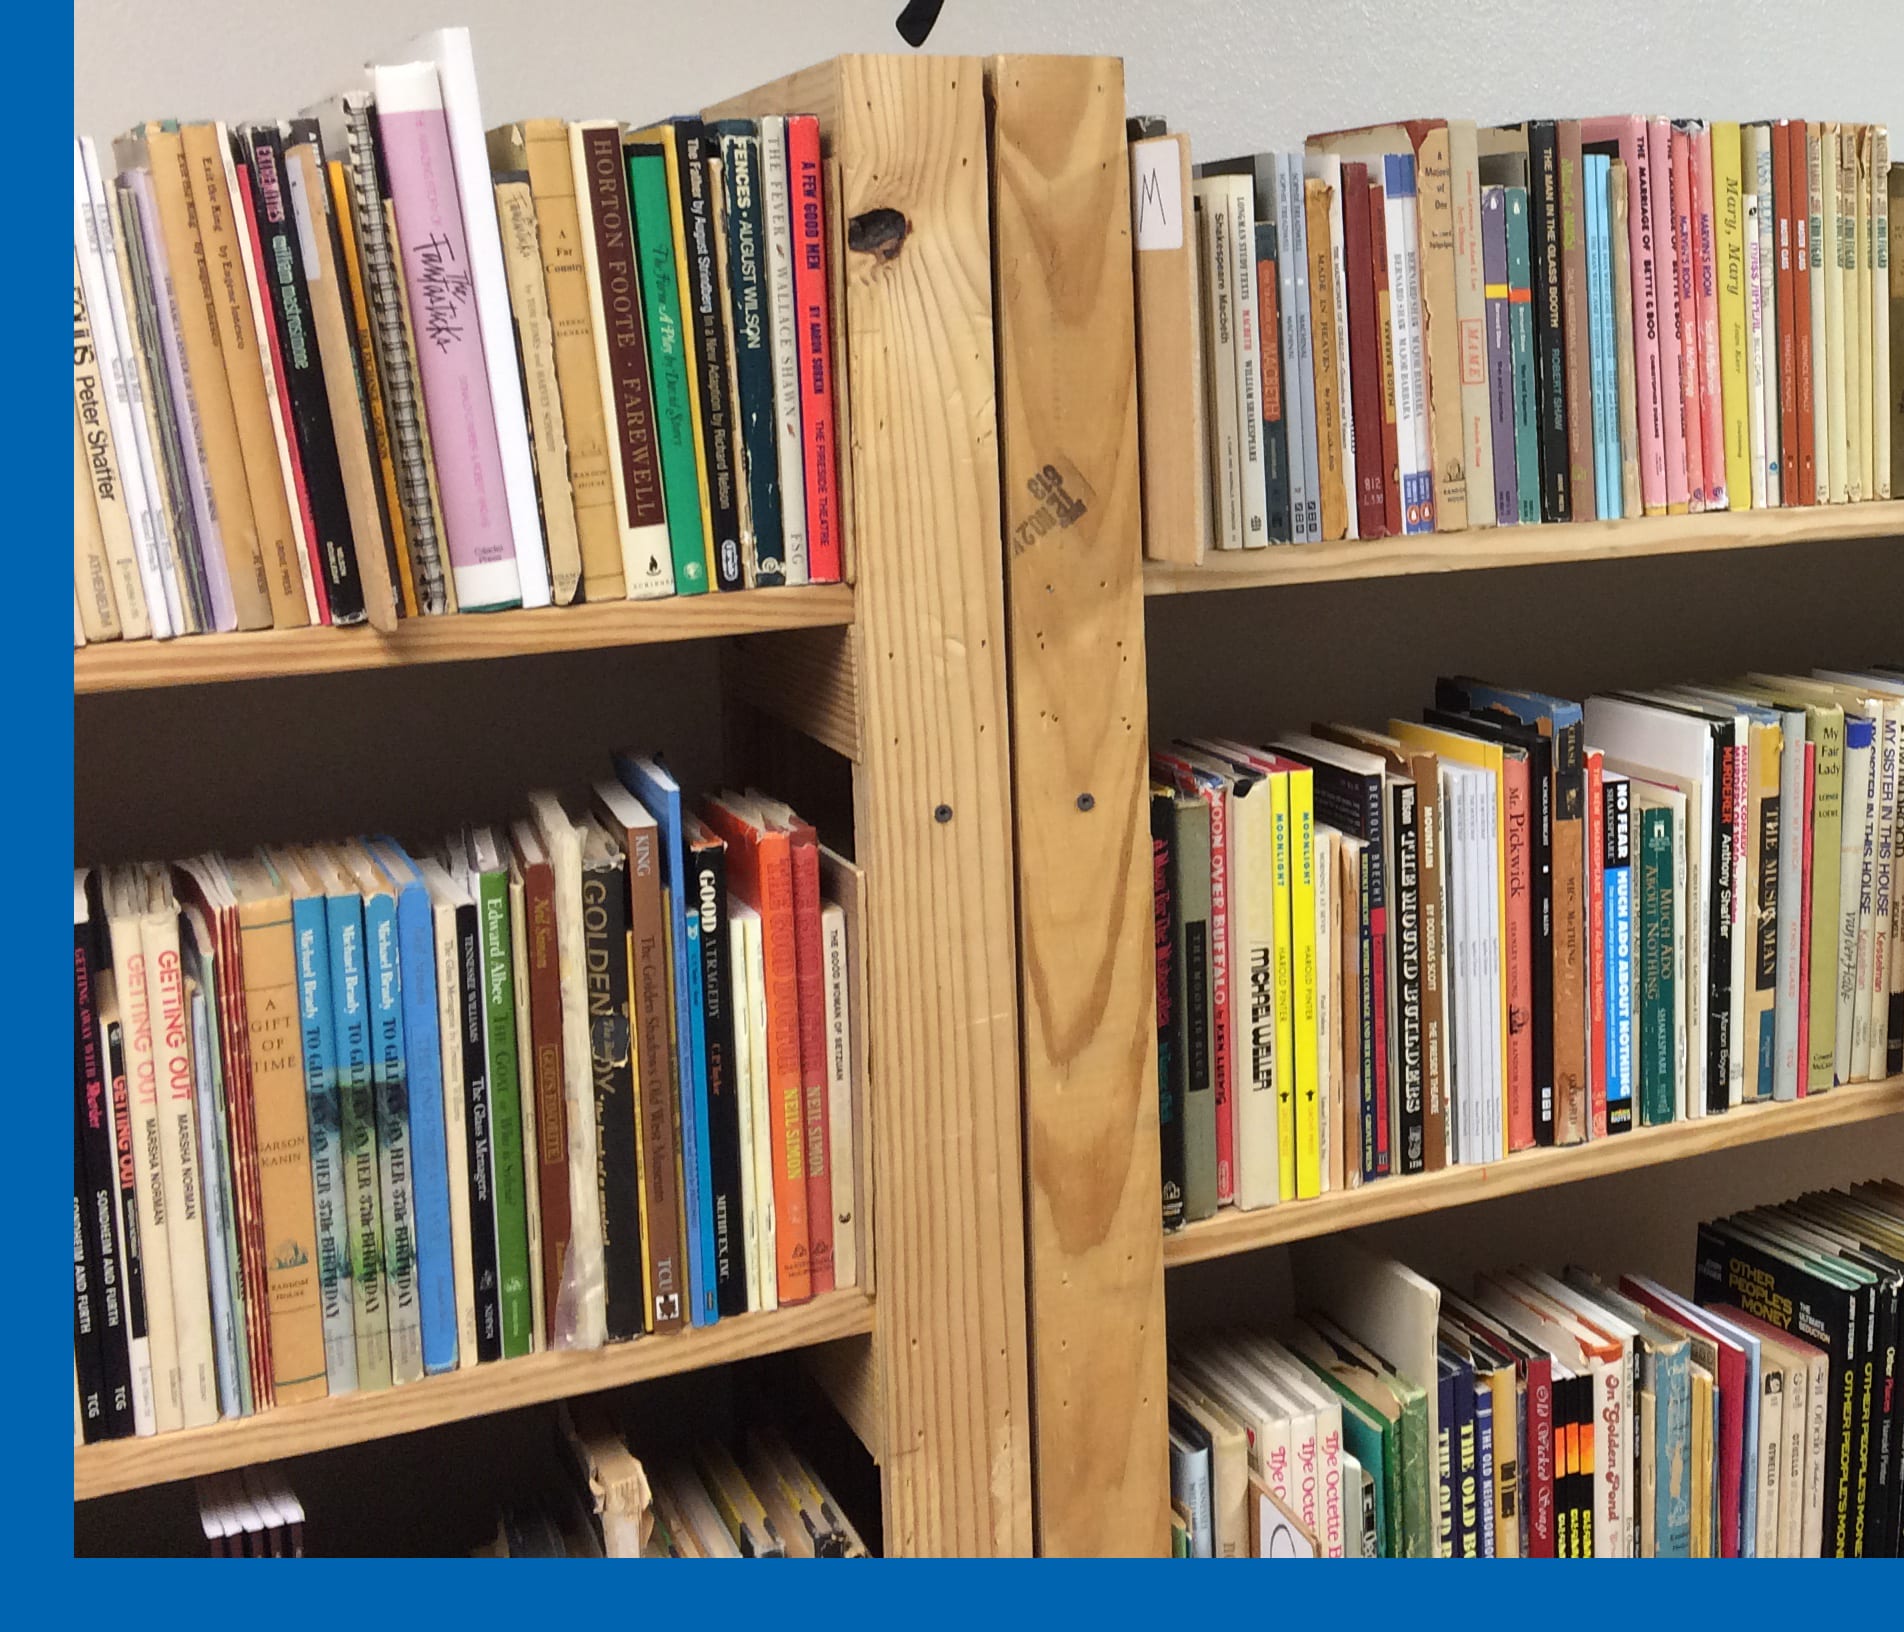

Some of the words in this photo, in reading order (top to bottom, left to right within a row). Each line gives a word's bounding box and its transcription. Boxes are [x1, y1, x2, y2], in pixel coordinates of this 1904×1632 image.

[595, 142, 623, 248] HORTON
[737, 139, 750, 212] FENCES
[1140, 168, 1166, 232] M
[608, 258, 634, 348] FOOTE
[624, 378, 656, 516] FAREWELL
[1818, 762, 1840, 776] Lady
[1823, 745, 1838, 759] Fair
[1824, 728, 1838, 745] My
[158, 950, 186, 1048] GETTING
[168, 1056, 190, 1102] OUT
